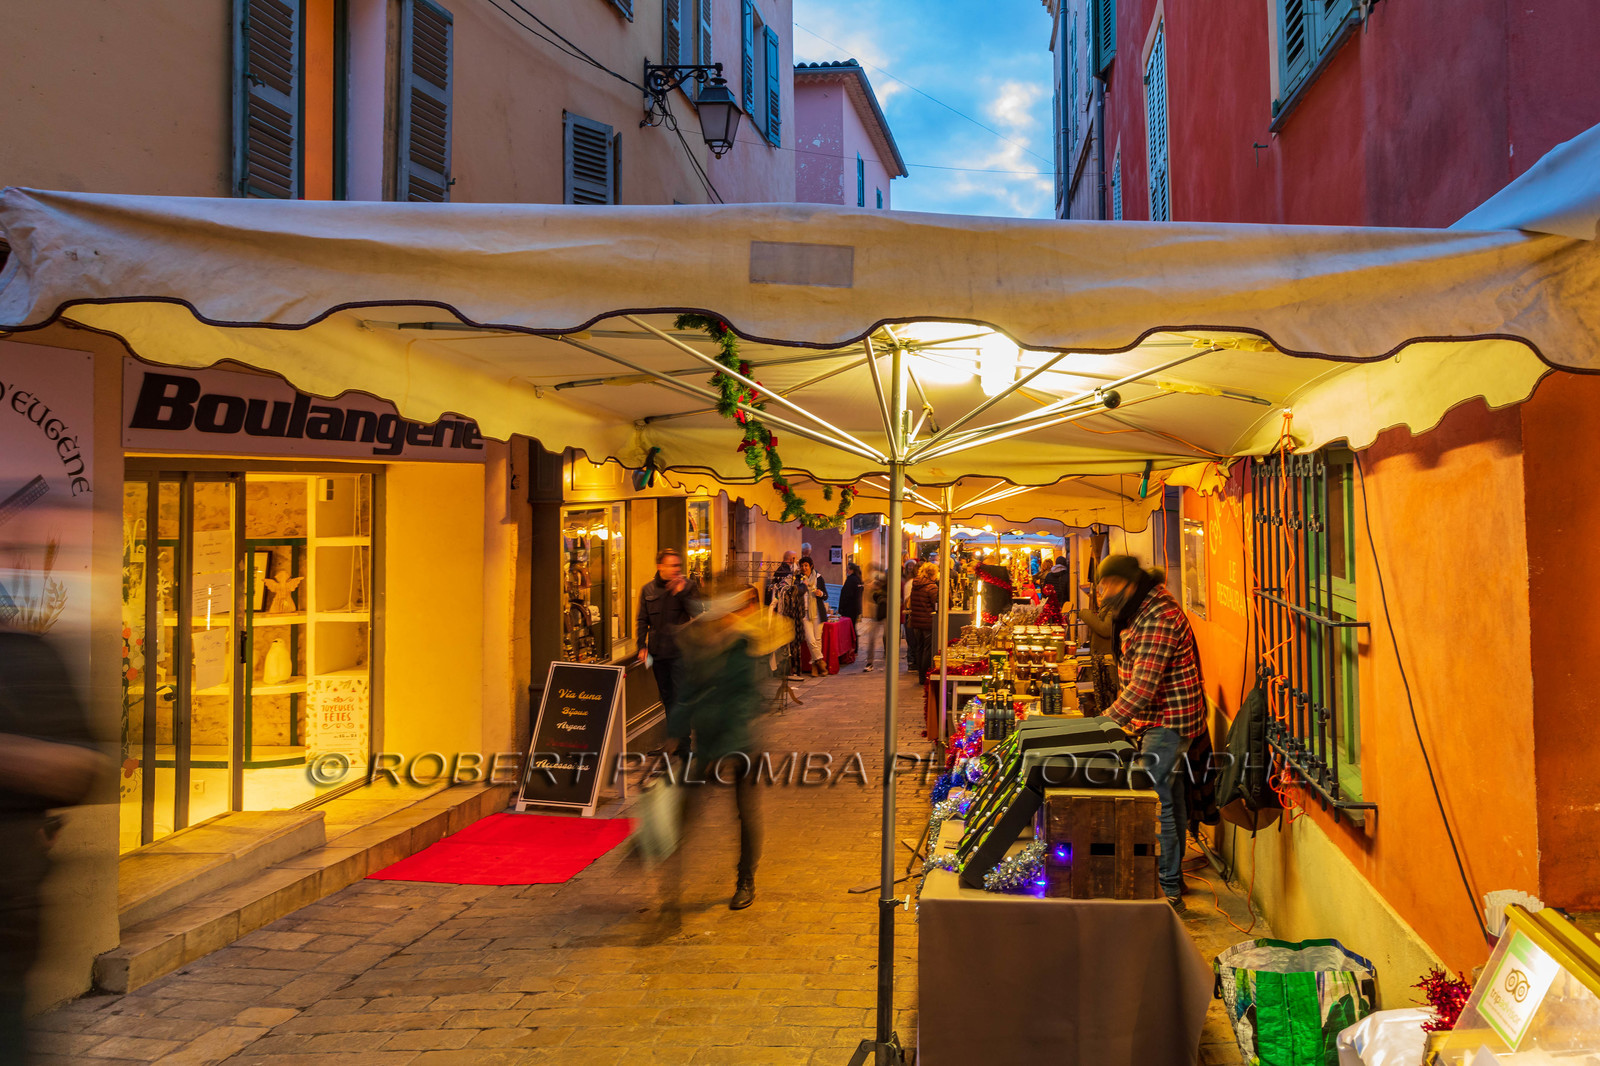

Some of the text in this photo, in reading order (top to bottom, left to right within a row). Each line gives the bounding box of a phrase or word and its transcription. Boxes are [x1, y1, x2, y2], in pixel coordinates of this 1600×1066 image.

[129, 372, 484, 455] Boulangerie
[0, 381, 93, 497] 'EUGÈNE
[558, 689, 602, 700] Via luna
[562, 707, 589, 716] Bijoux
[556, 721, 587, 732] Argent
